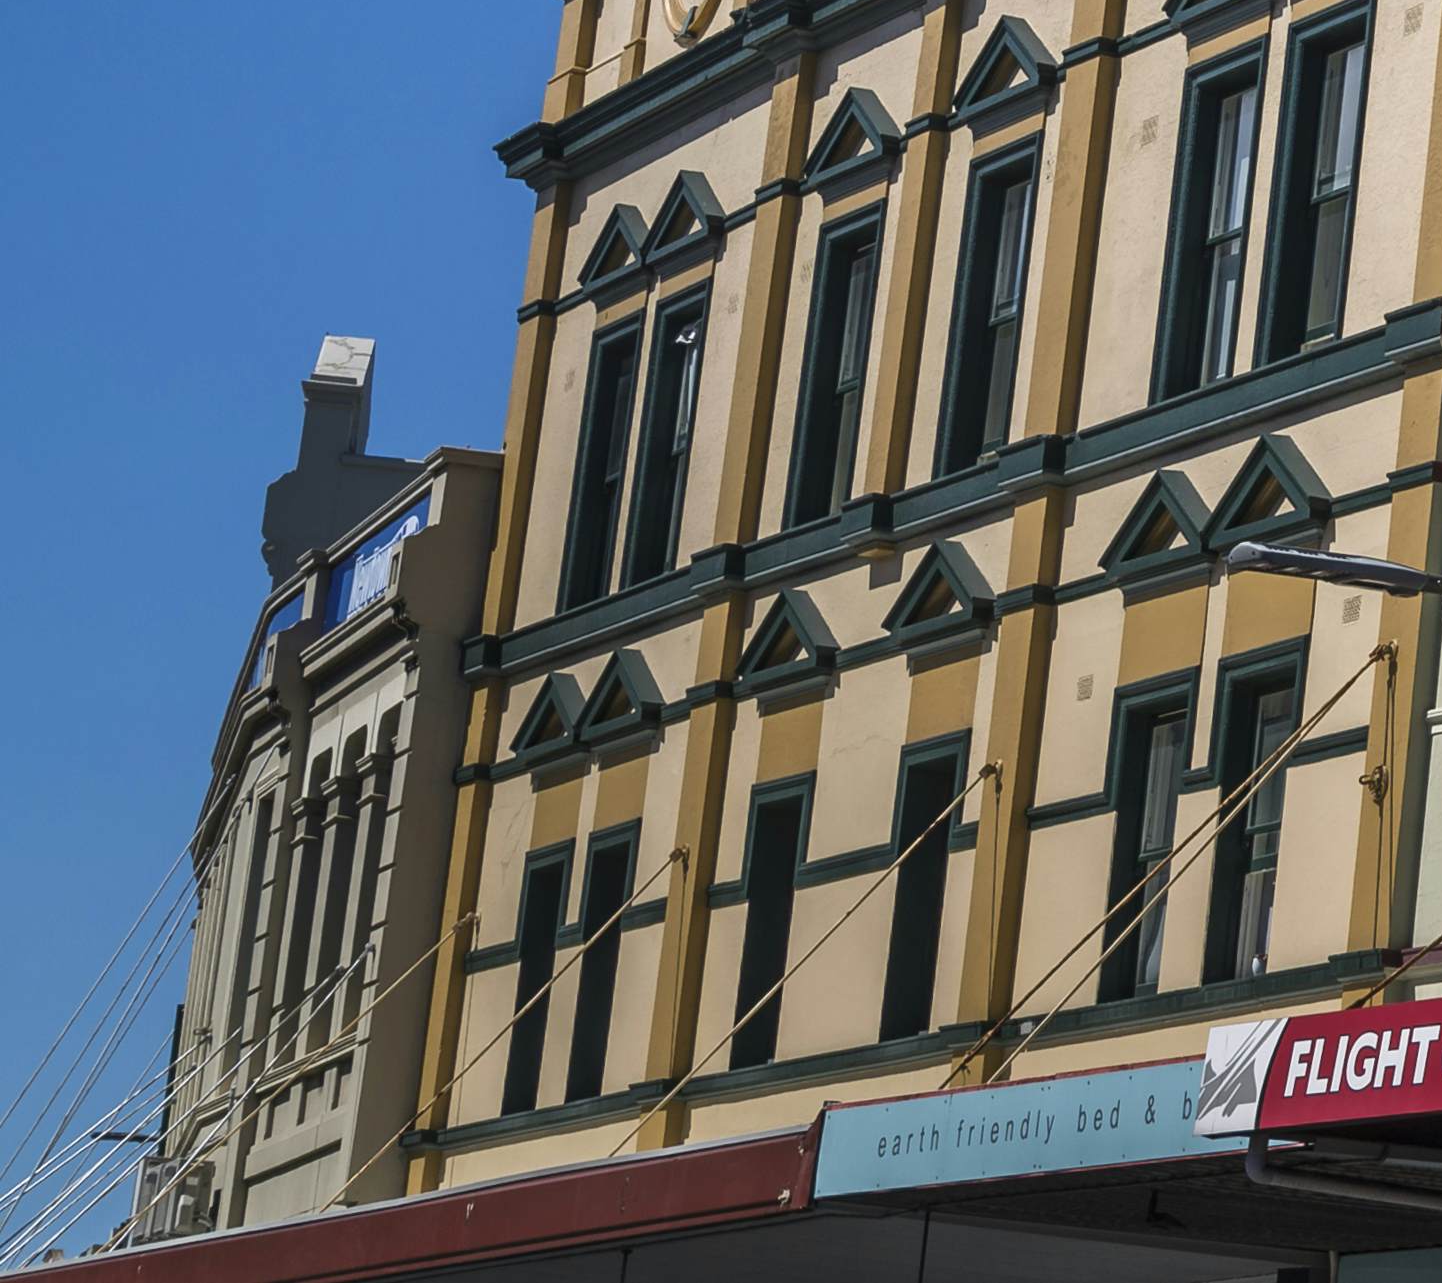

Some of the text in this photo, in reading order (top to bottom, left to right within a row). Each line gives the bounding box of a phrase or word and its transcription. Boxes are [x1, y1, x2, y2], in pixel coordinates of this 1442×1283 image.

[1283, 1025, 1441, 1098] FLIGHT
[878, 1125, 940, 1158] earth
[956, 1110, 1055, 1149] friendly
[1077, 1100, 1120, 1132] bed
[1144, 1094, 1156, 1125] &
